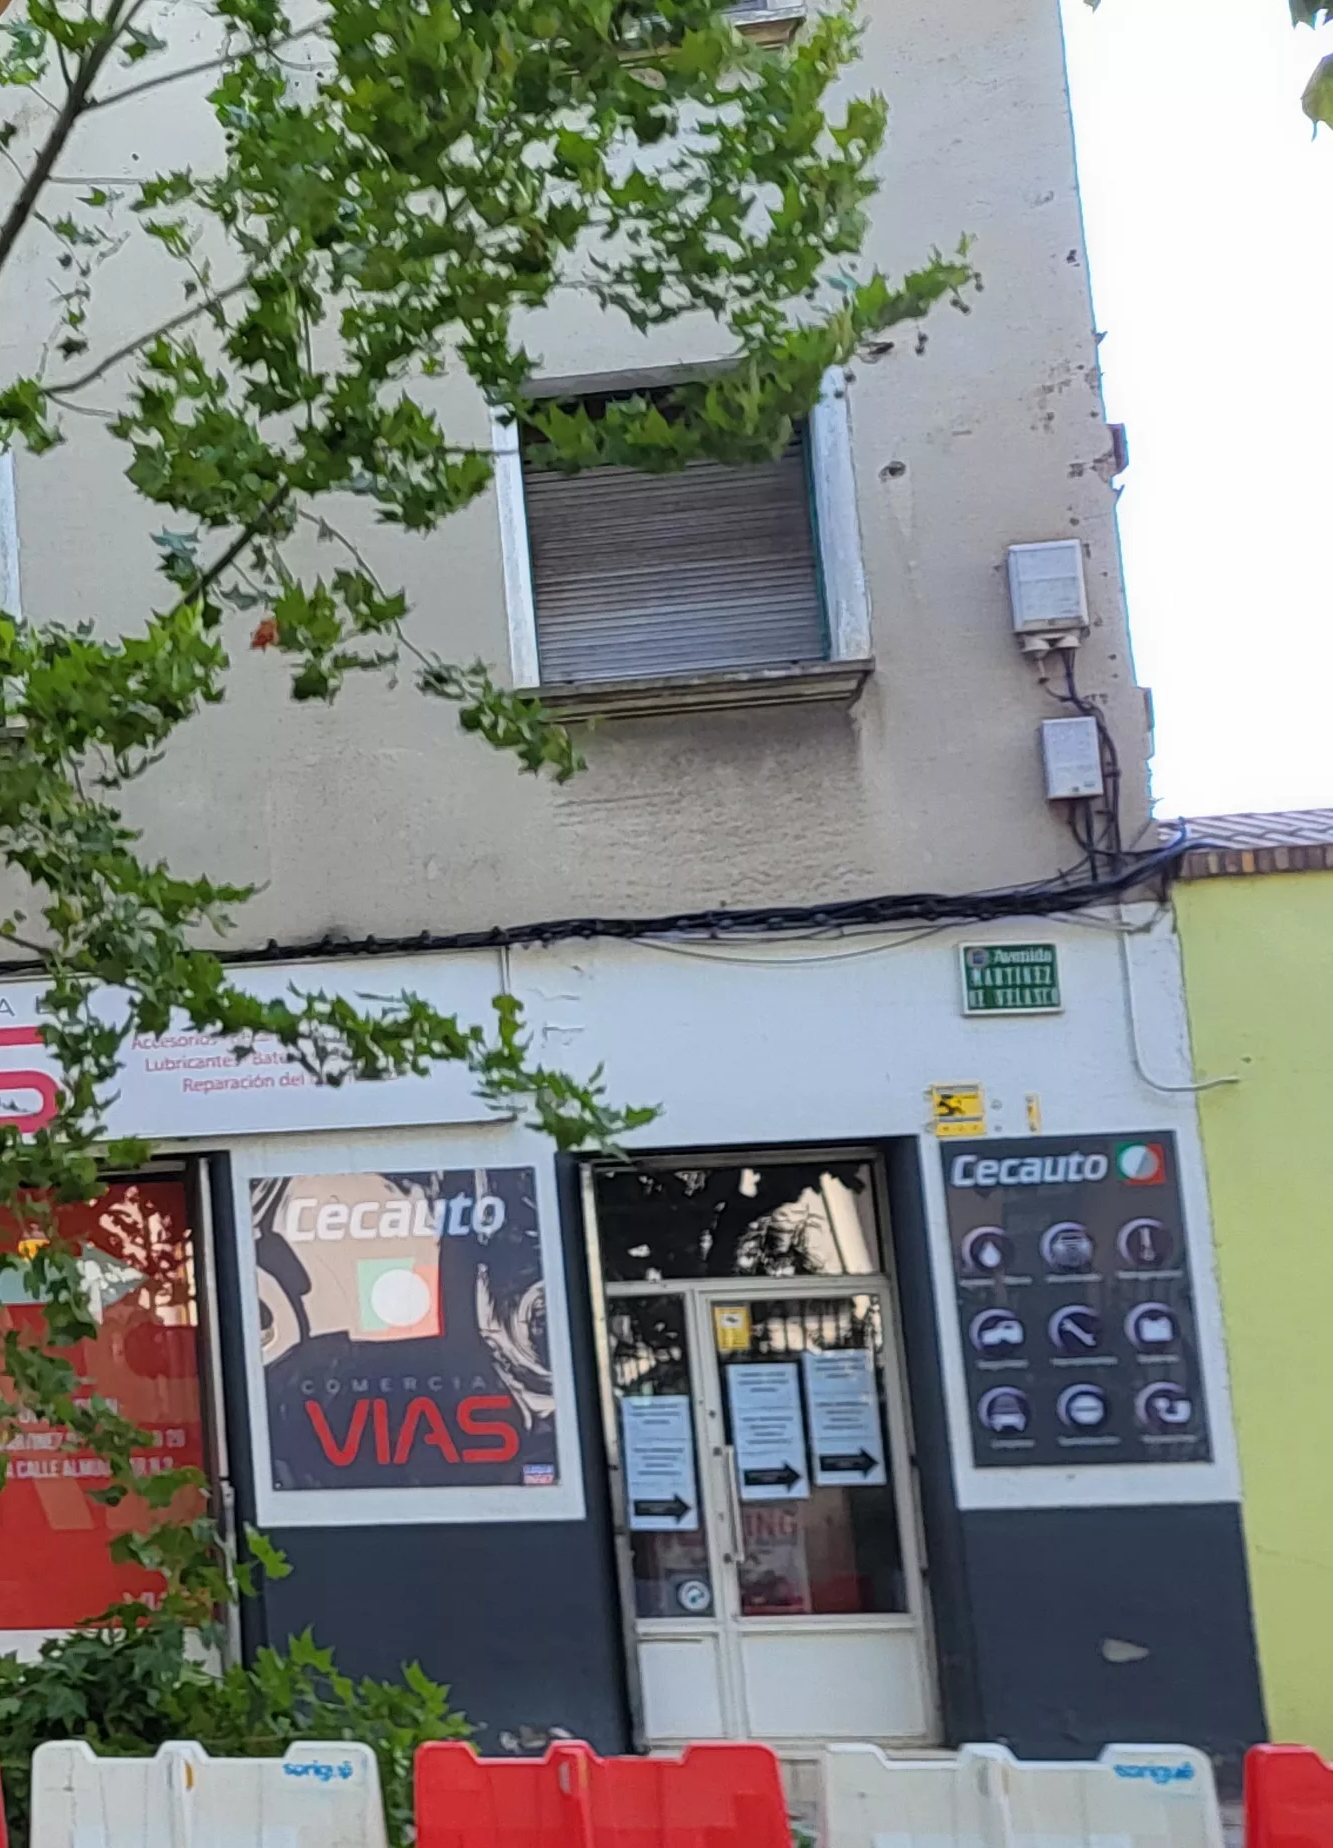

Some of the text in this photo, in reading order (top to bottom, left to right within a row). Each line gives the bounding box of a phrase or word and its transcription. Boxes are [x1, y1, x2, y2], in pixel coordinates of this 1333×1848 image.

[145, 1054, 236, 1073] Lubricante
[182, 1075, 275, 1094] Reparación
[279, 1072, 305, 1087] del
[951, 1151, 1109, 1188] Cecauto
[286, 1191, 506, 1242] Cecauto
[304, 1395, 521, 1468] VIAS
